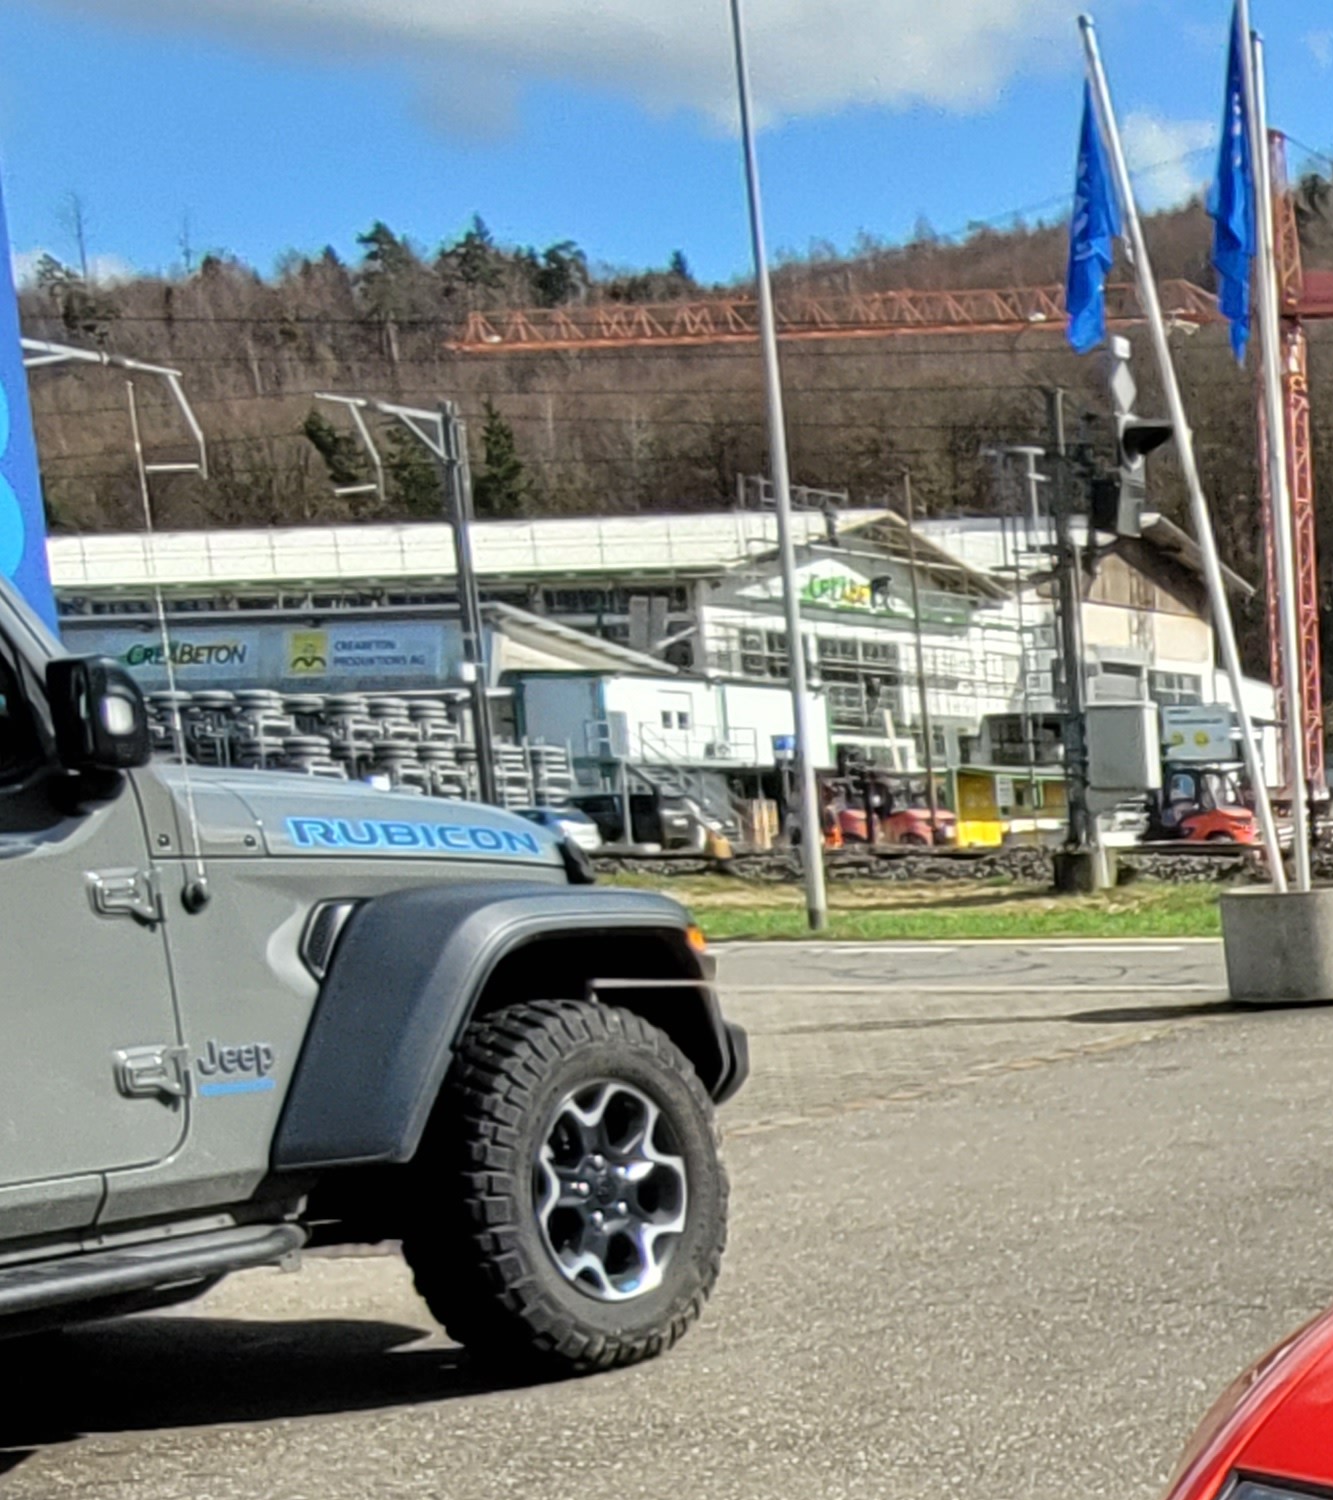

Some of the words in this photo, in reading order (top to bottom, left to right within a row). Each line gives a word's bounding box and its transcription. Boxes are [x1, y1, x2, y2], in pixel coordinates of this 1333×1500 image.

[125, 641, 247, 666] CREABETON
[288, 818, 541, 854] RUBICON
[197, 1040, 274, 1077] Jeep
